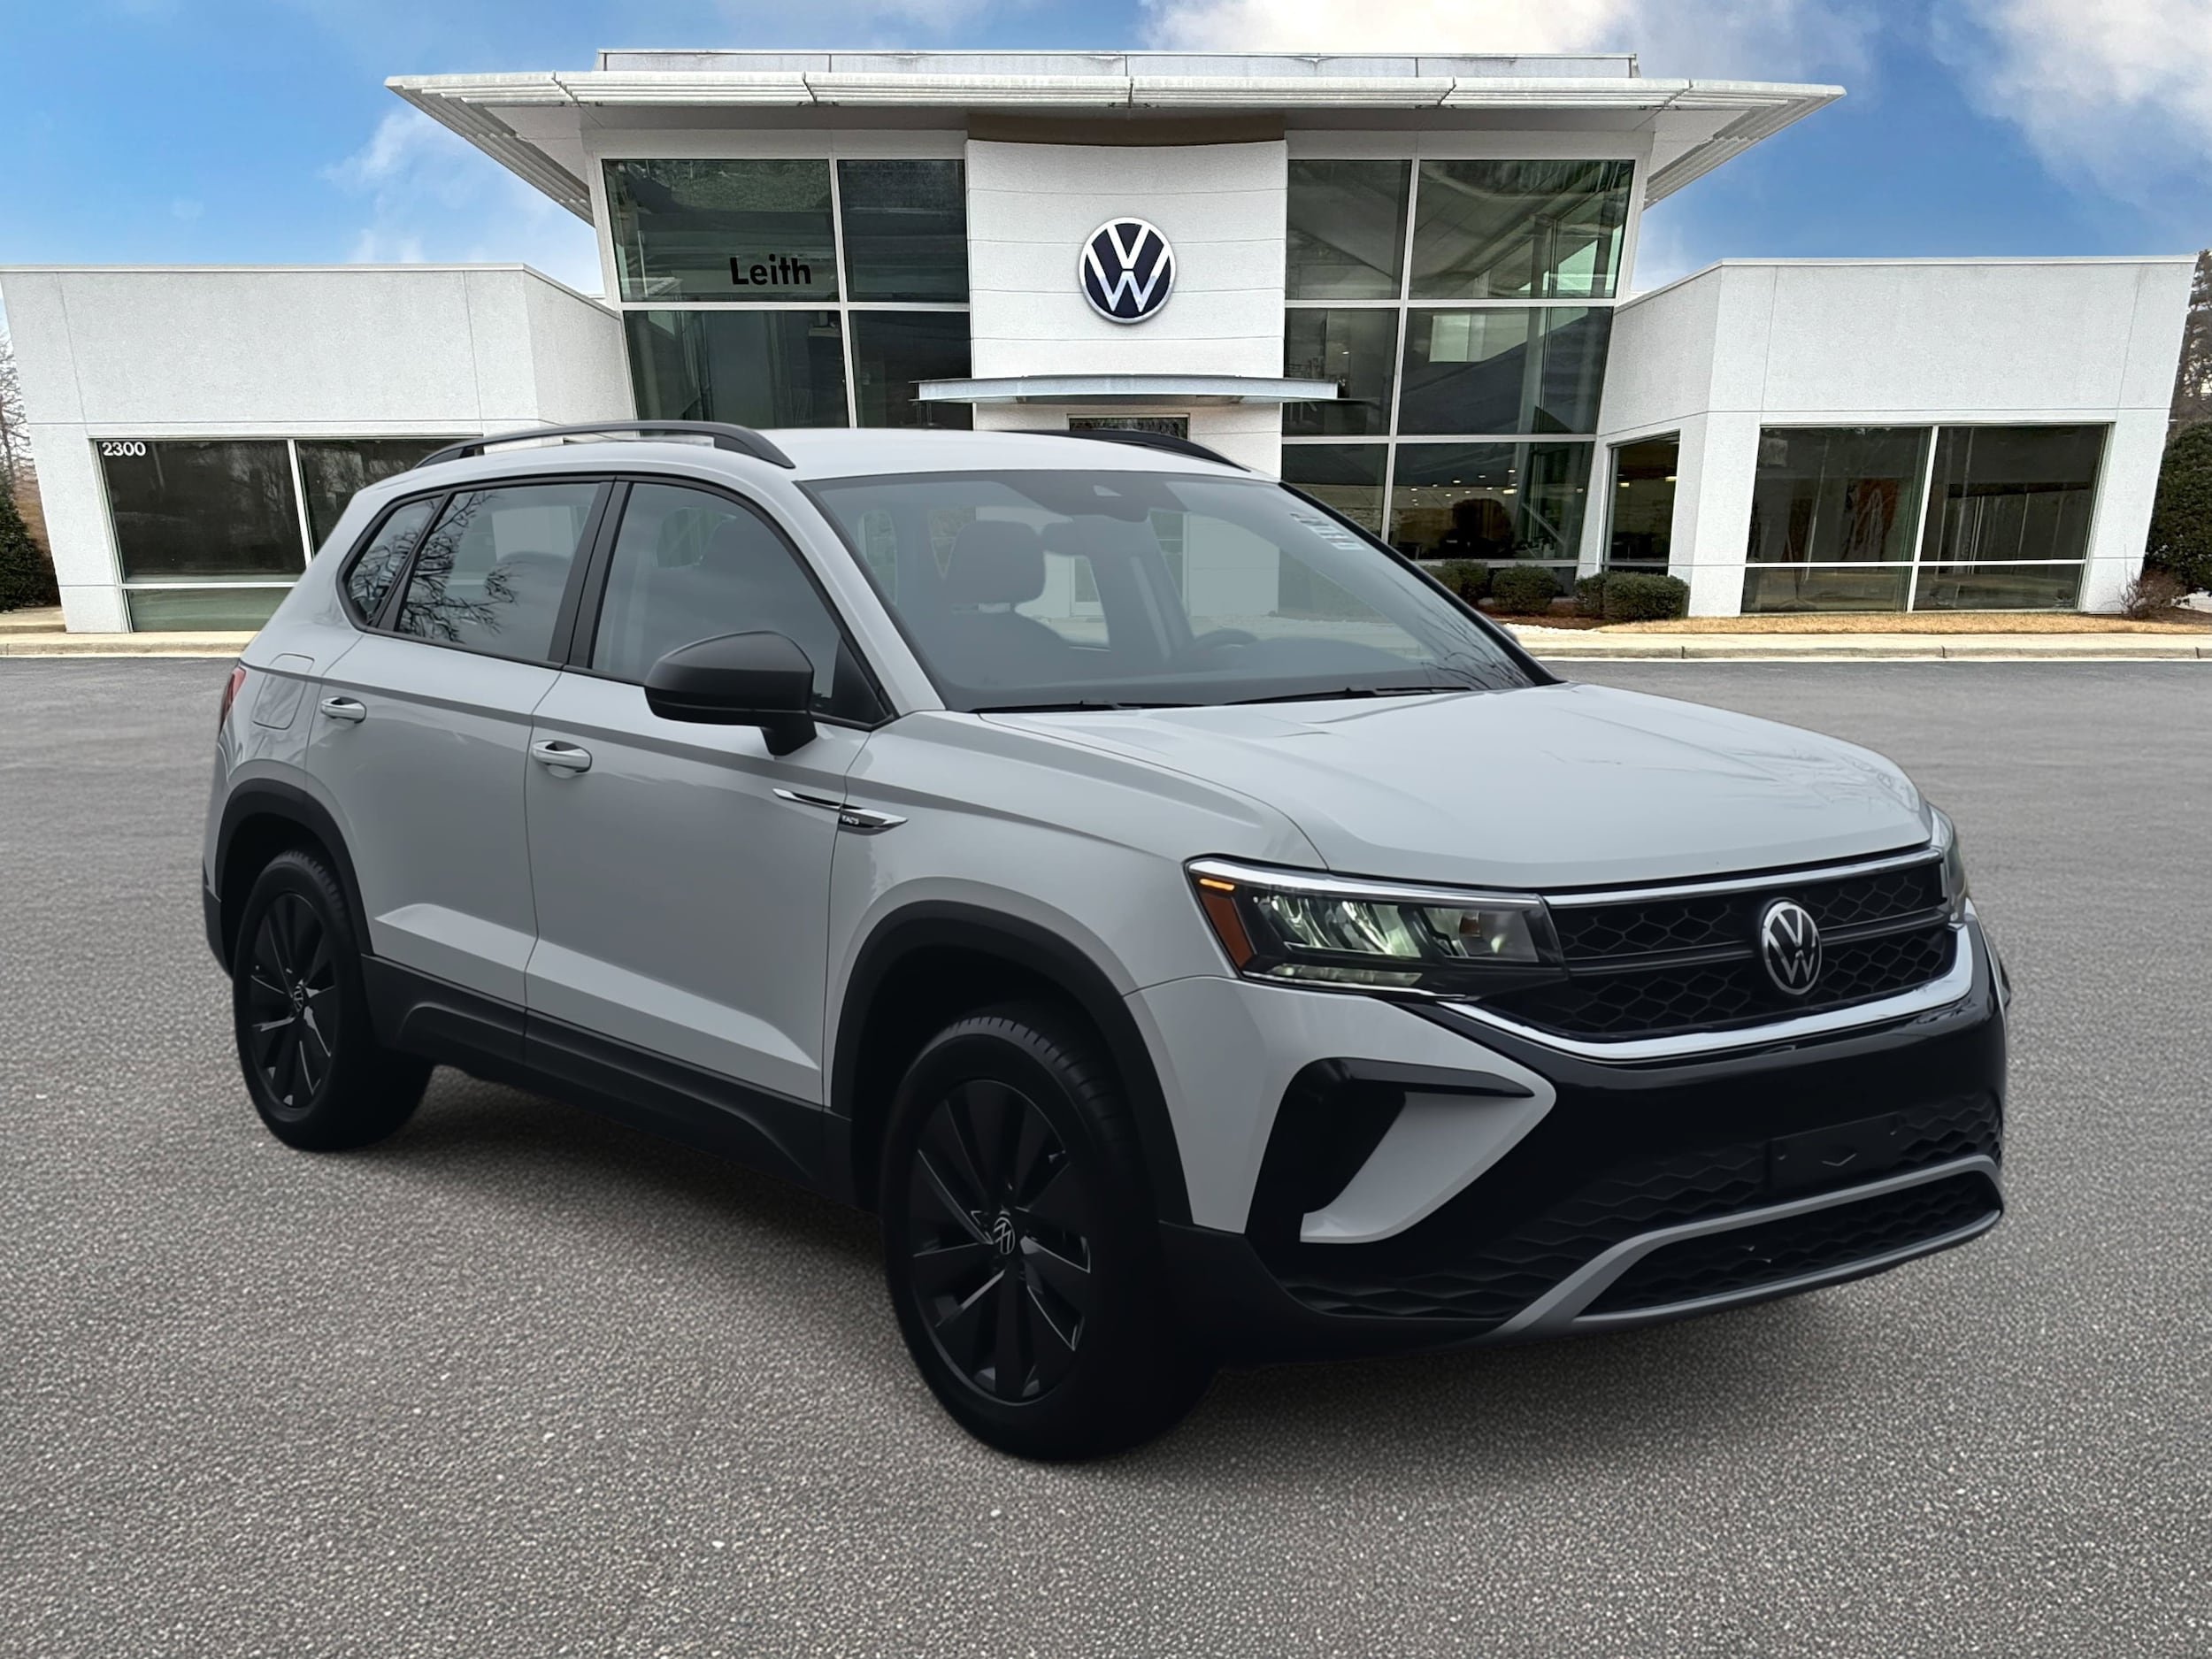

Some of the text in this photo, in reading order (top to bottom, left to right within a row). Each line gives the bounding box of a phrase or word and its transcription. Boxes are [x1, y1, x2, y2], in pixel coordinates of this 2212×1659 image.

[730, 254, 811, 285] Leith
[1080, 218, 1175, 321] VW
[102, 442, 146, 457] 2300
[1763, 902, 1821, 993] VW
